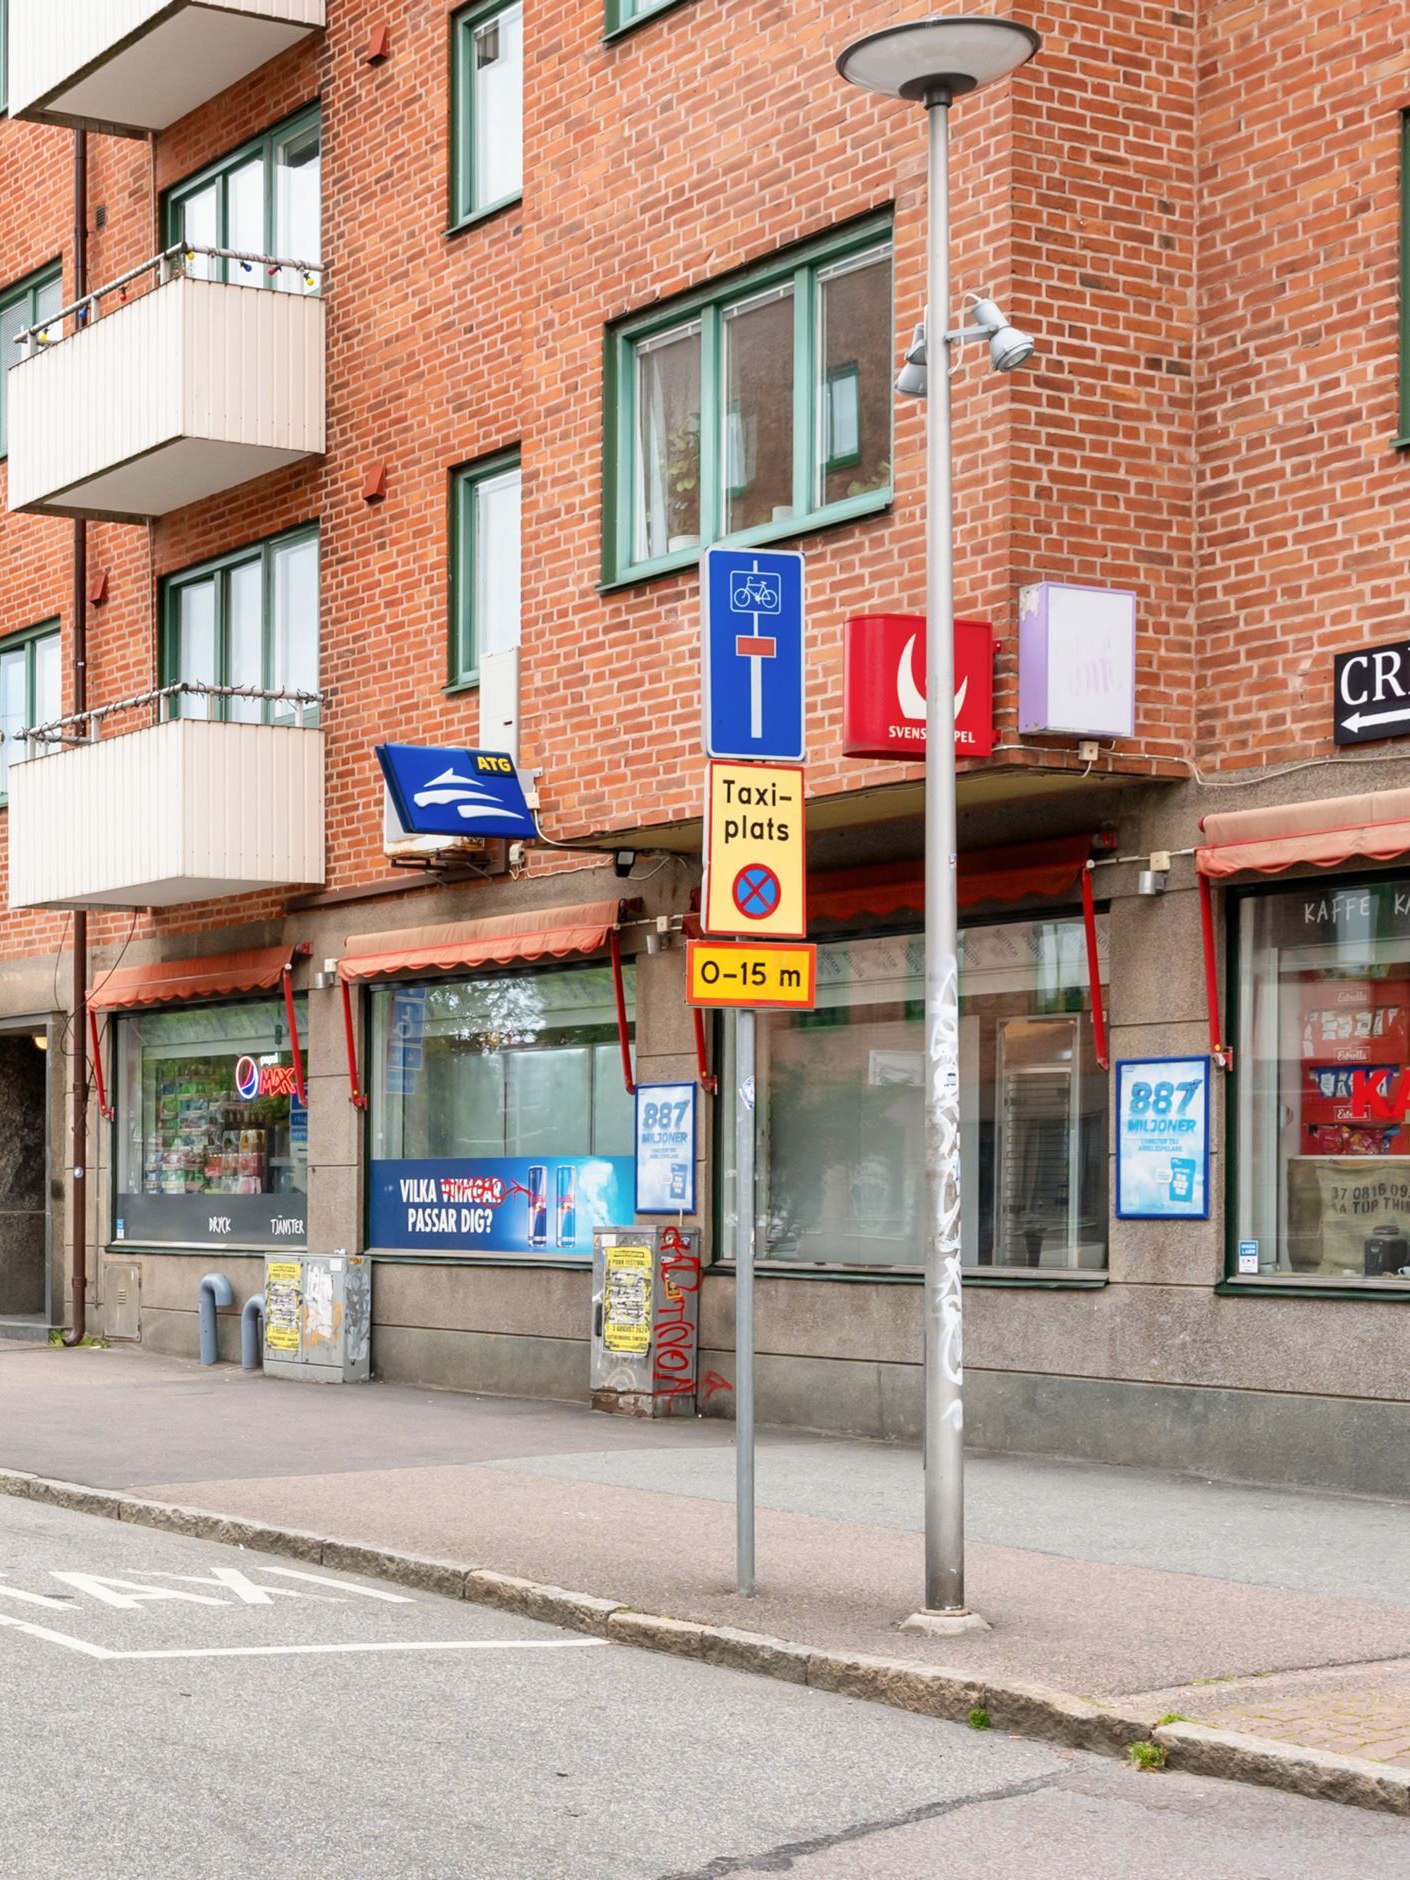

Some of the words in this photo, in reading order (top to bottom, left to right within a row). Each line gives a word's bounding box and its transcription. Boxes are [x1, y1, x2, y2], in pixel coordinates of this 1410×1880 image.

[1340, 647, 1410, 706] CR
[476, 756, 512, 773] ATG
[722, 779, 793, 807] Taxi-
[724, 815, 790, 844] plats
[1304, 894, 1370, 924] KAFFE
[701, 960, 767, 987] 0-15
[779, 967, 801, 988] m
[1336, 1048, 1368, 1062] Estrella
[259, 1067, 297, 1097] MAX
[1129, 1078, 1202, 1116] 887
[643, 1100, 690, 1130] 887
[1127, 1118, 1197, 1134] MILJONER
[641, 1131, 688, 1144] MILJONER
[399, 1179, 438, 1203] VILKA
[208, 1216, 232, 1234] DRYCK
[270, 1214, 305, 1235] TJÄNSTER
[407, 1208, 457, 1233] PASSAR
[461, 1208, 494, 1234] DIG?
